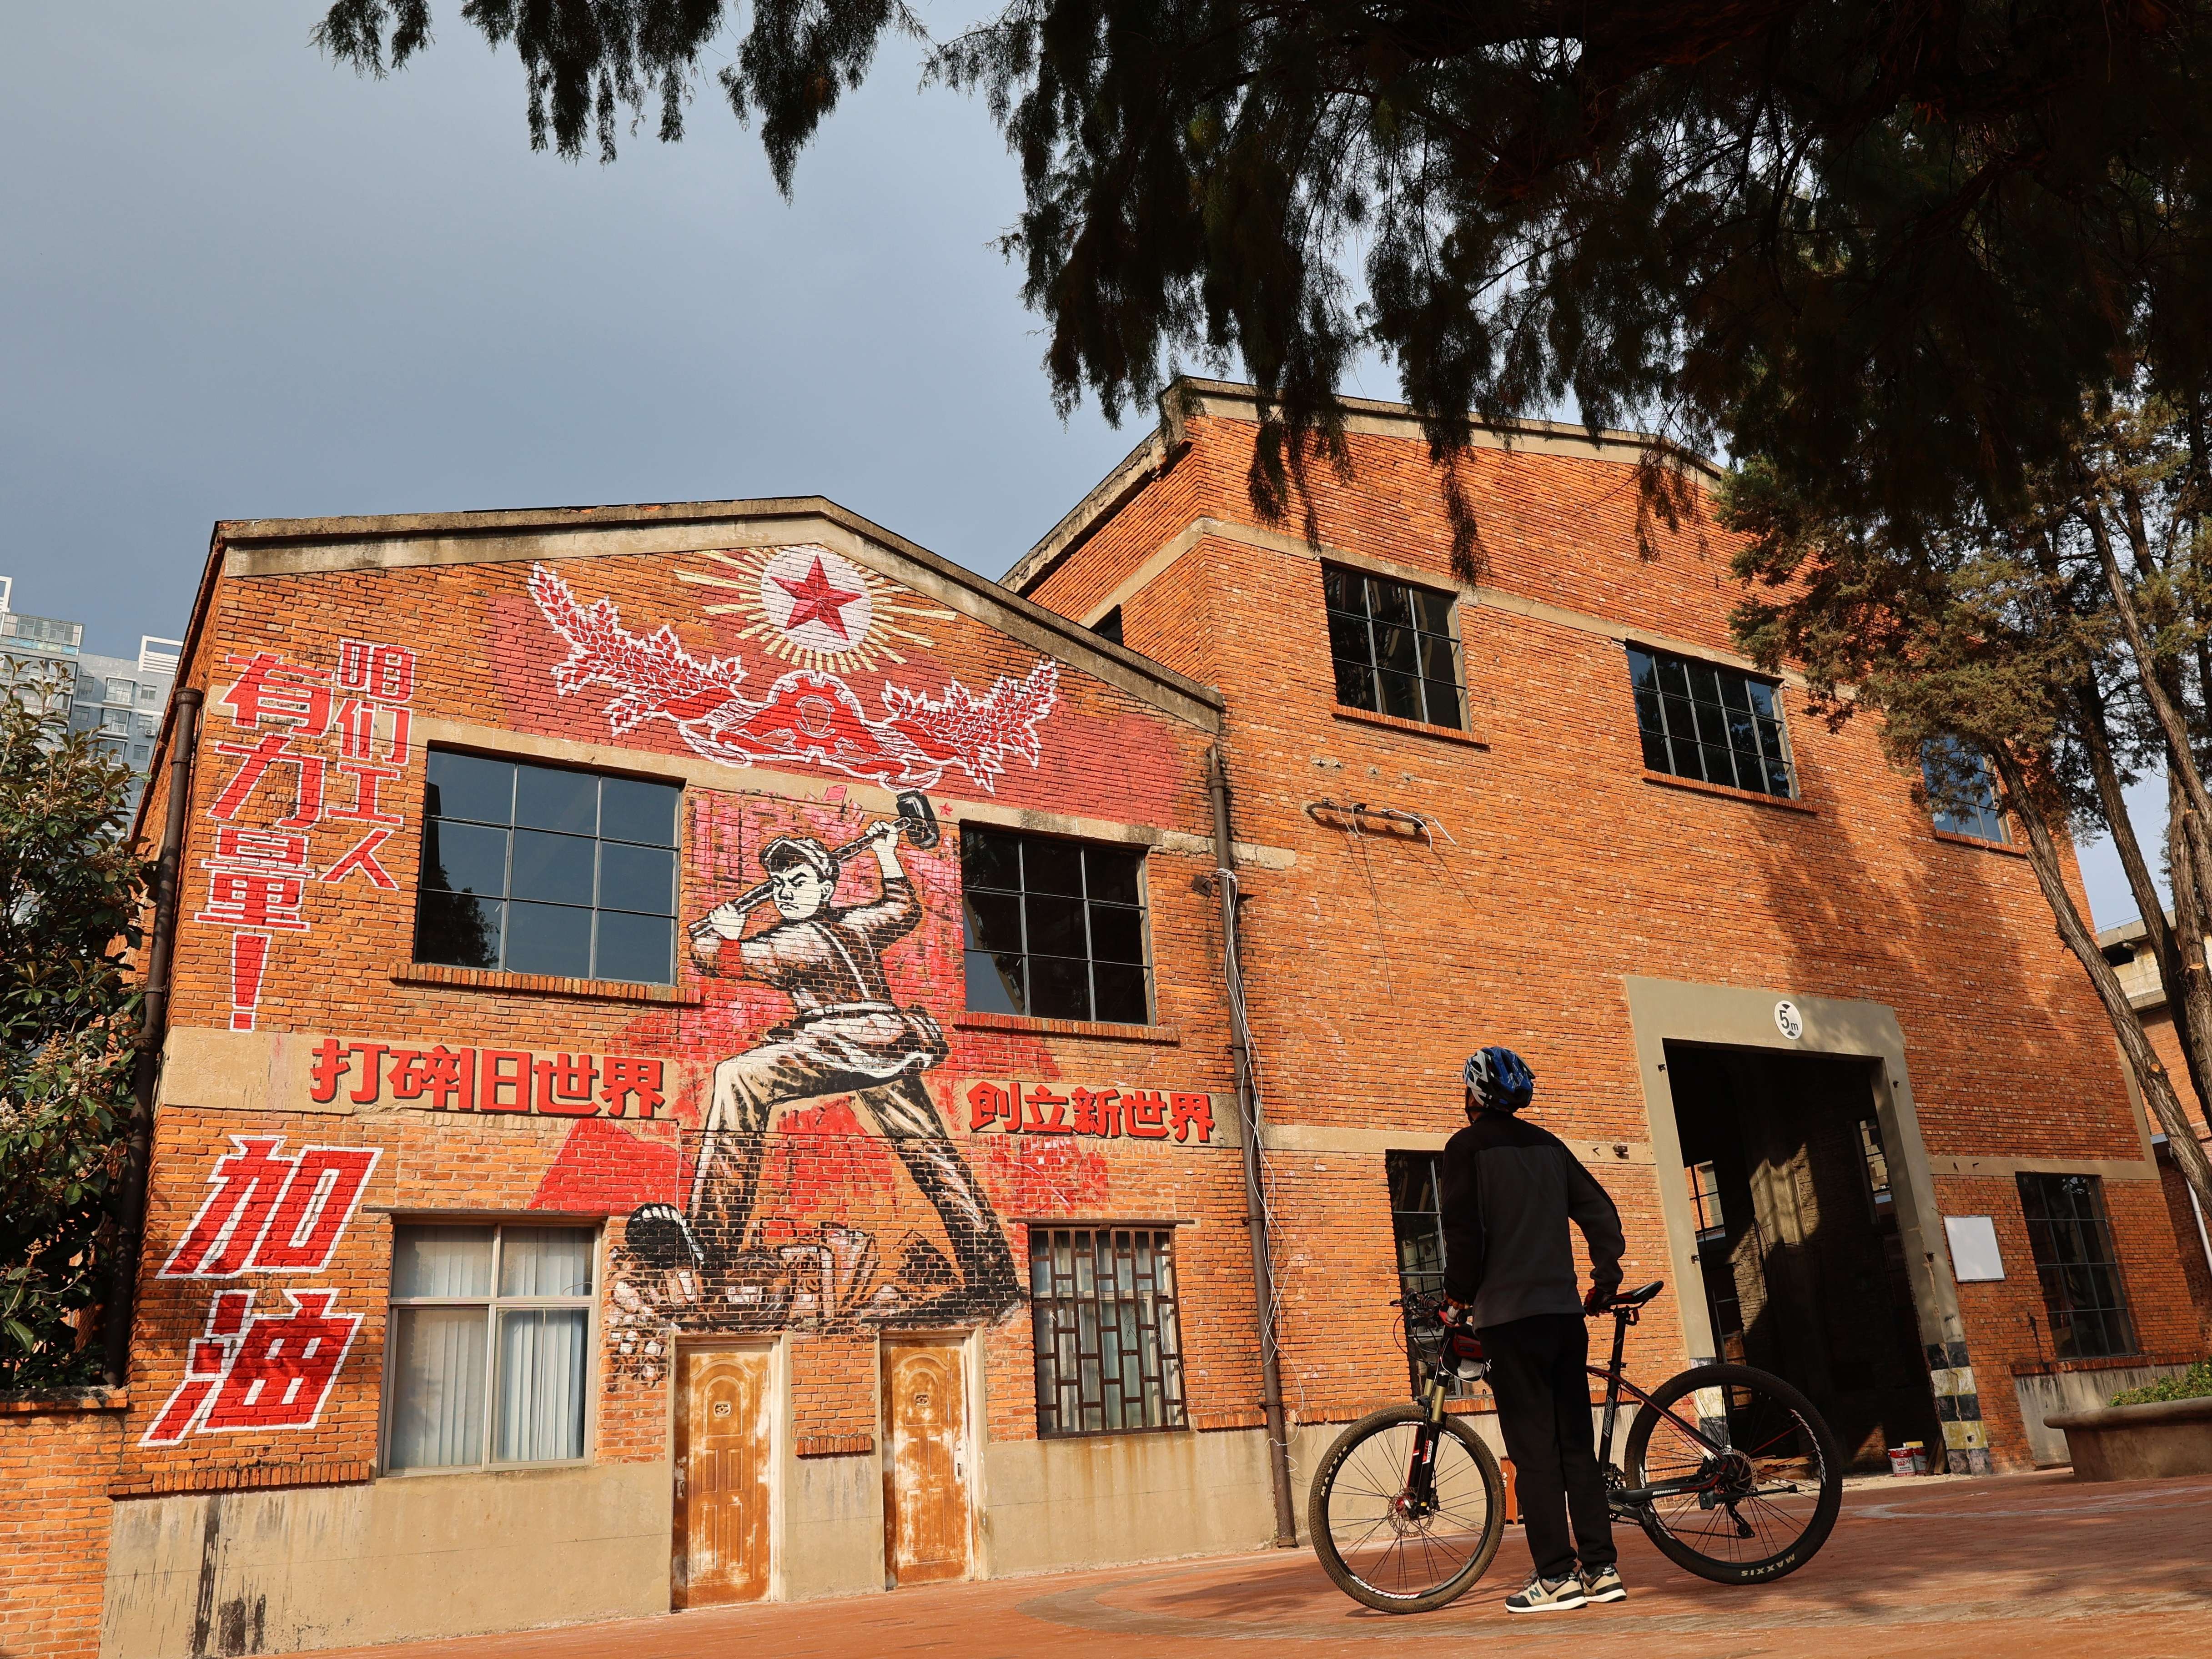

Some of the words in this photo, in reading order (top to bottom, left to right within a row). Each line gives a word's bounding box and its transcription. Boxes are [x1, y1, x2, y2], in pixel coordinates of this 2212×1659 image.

[318, 638, 417, 891] 咱们工人
[310, 1038, 665, 1119] 打碎旧世界
[137, 1134, 383, 1447] 加油
[1321, 1446, 1347, 1497] MAXXIS
[1652, 1488, 1680, 1496] ROMANCE
[1349, 1574, 1422, 1599] ROMANCE
[1741, 1553, 1795, 1576] MAXXIS
